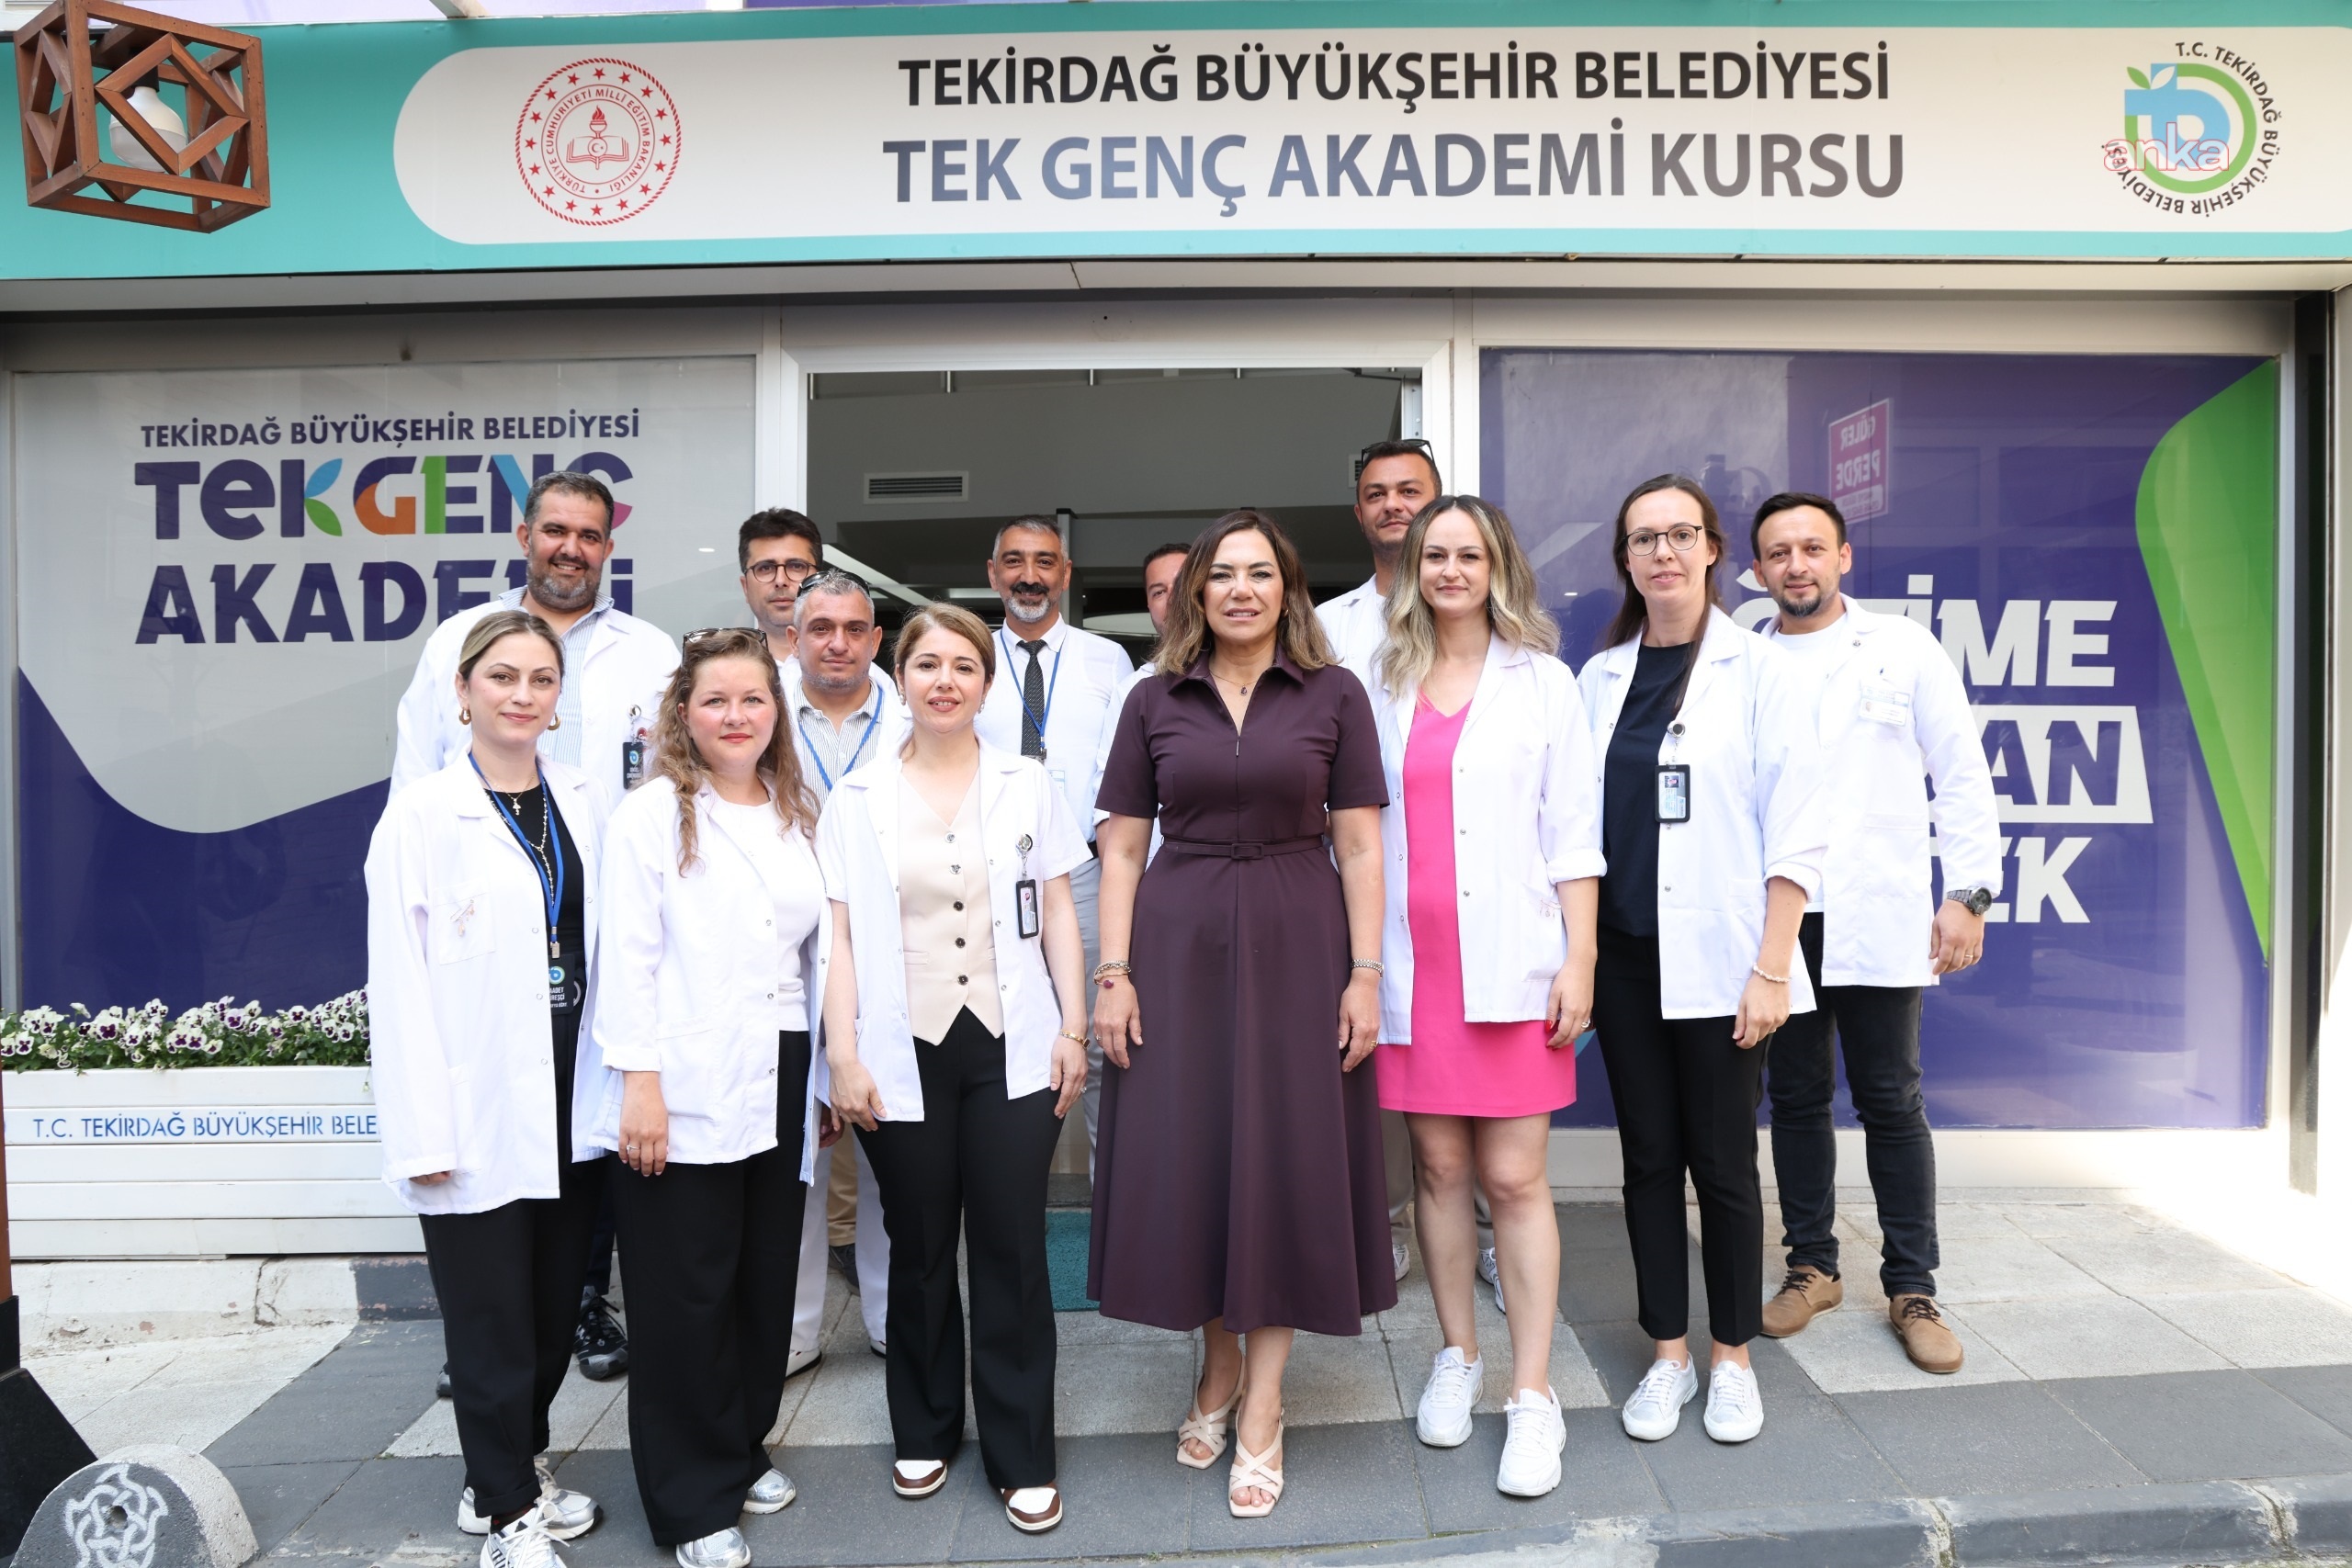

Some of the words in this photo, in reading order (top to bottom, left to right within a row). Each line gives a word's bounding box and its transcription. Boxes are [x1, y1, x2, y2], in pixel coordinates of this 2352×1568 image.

[898, 43, 1179, 107] TEKİRDAĞ
[1196, 39, 1559, 115] BÜYÜKŞEHİR
[1575, 39, 1889, 100] BELEDİYESİ
[2175, 41, 2208, 58] T.C.
[2214, 45, 2282, 124] TEKİRDAĞ
[546, 88, 592, 155] CUMHURİYETİ
[627, 99, 650, 137] EĞİTİM
[548, 157, 586, 194] TÜRKİYE
[609, 141, 650, 193] BAKANLIĞI
[882, 138, 1023, 203] TEK
[1041, 134, 1247, 218] GENÇ
[1267, 117, 1624, 197] AKADEMİ
[1651, 132, 1904, 198] KURSU
[2190, 130, 2281, 218] BÜYÜKŞEHİR
[140, 416, 282, 448] TEKİRDAĞ
[290, 411, 475, 448] BÜYÜKŞEHİR
[483, 407, 639, 440] BELEDİYESİ
[134, 558, 634, 645] AKADEİ
[33, 1118, 73, 1139] T.C.
[81, 1111, 186, 1138] TEKİRDAĞ
[193, 1111, 323, 1139] BÜYÜKŞEHİR
[332, 1115, 379, 1135] BELE
